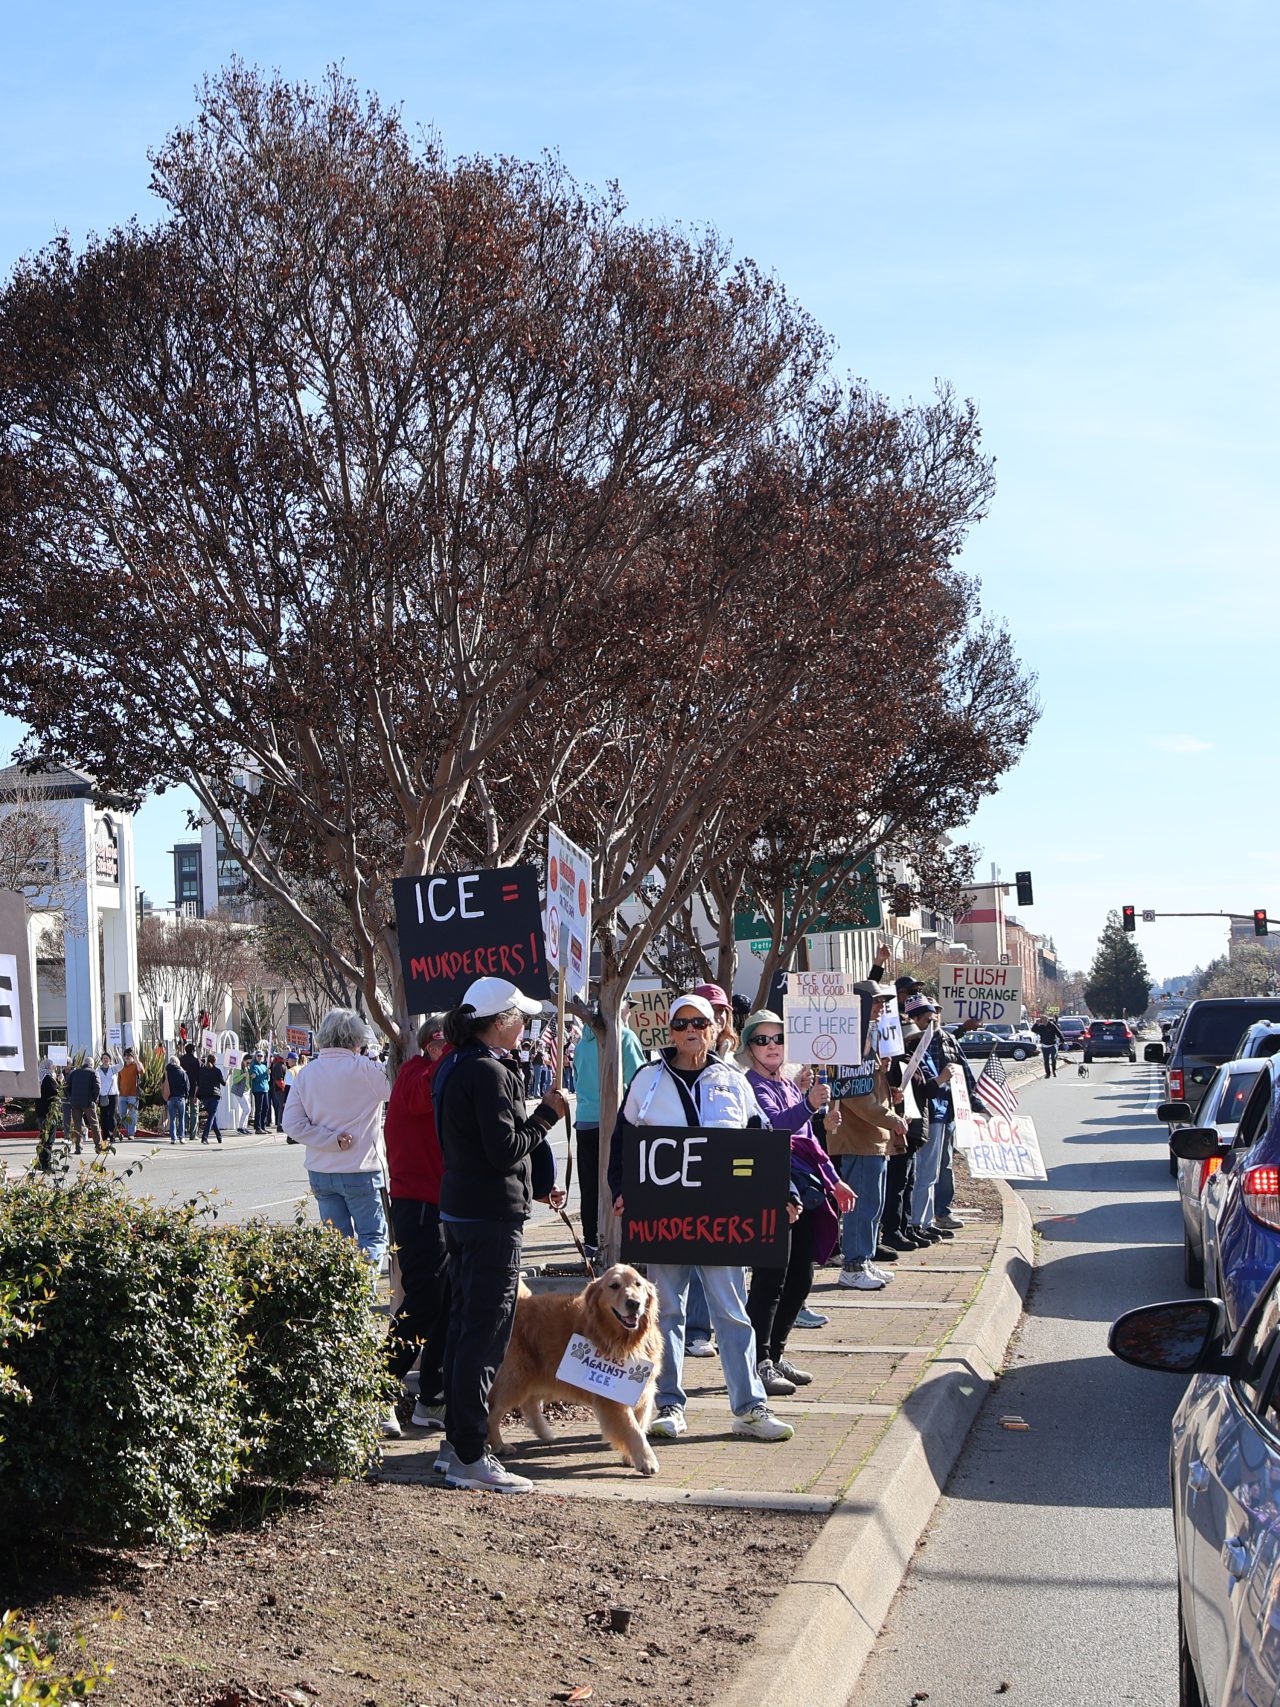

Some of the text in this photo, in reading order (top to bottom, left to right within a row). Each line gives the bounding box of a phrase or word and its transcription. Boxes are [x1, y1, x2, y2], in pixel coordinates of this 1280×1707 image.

[415, 875, 485, 924] ICE
[796, 974, 816, 986] ICE
[822, 973, 840, 984] OUT
[953, 967, 1007, 986] FLUSH
[802, 985, 819, 996] FOR
[942, 986, 1018, 1001] THE ORANGE
[642, 990, 674, 1011] HAT
[808, 995, 837, 1013] NO
[953, 1000, 1005, 1020] TURD
[786, 1015, 858, 1034] ICE HERE
[851, 1077, 874, 1095] FRIEND
[973, 1119, 1023, 1145] TUCK
[639, 1137, 708, 1187] ICE
[973, 1145, 1029, 1172] FRUMP
[581, 1356, 627, 1379] AGAINST
